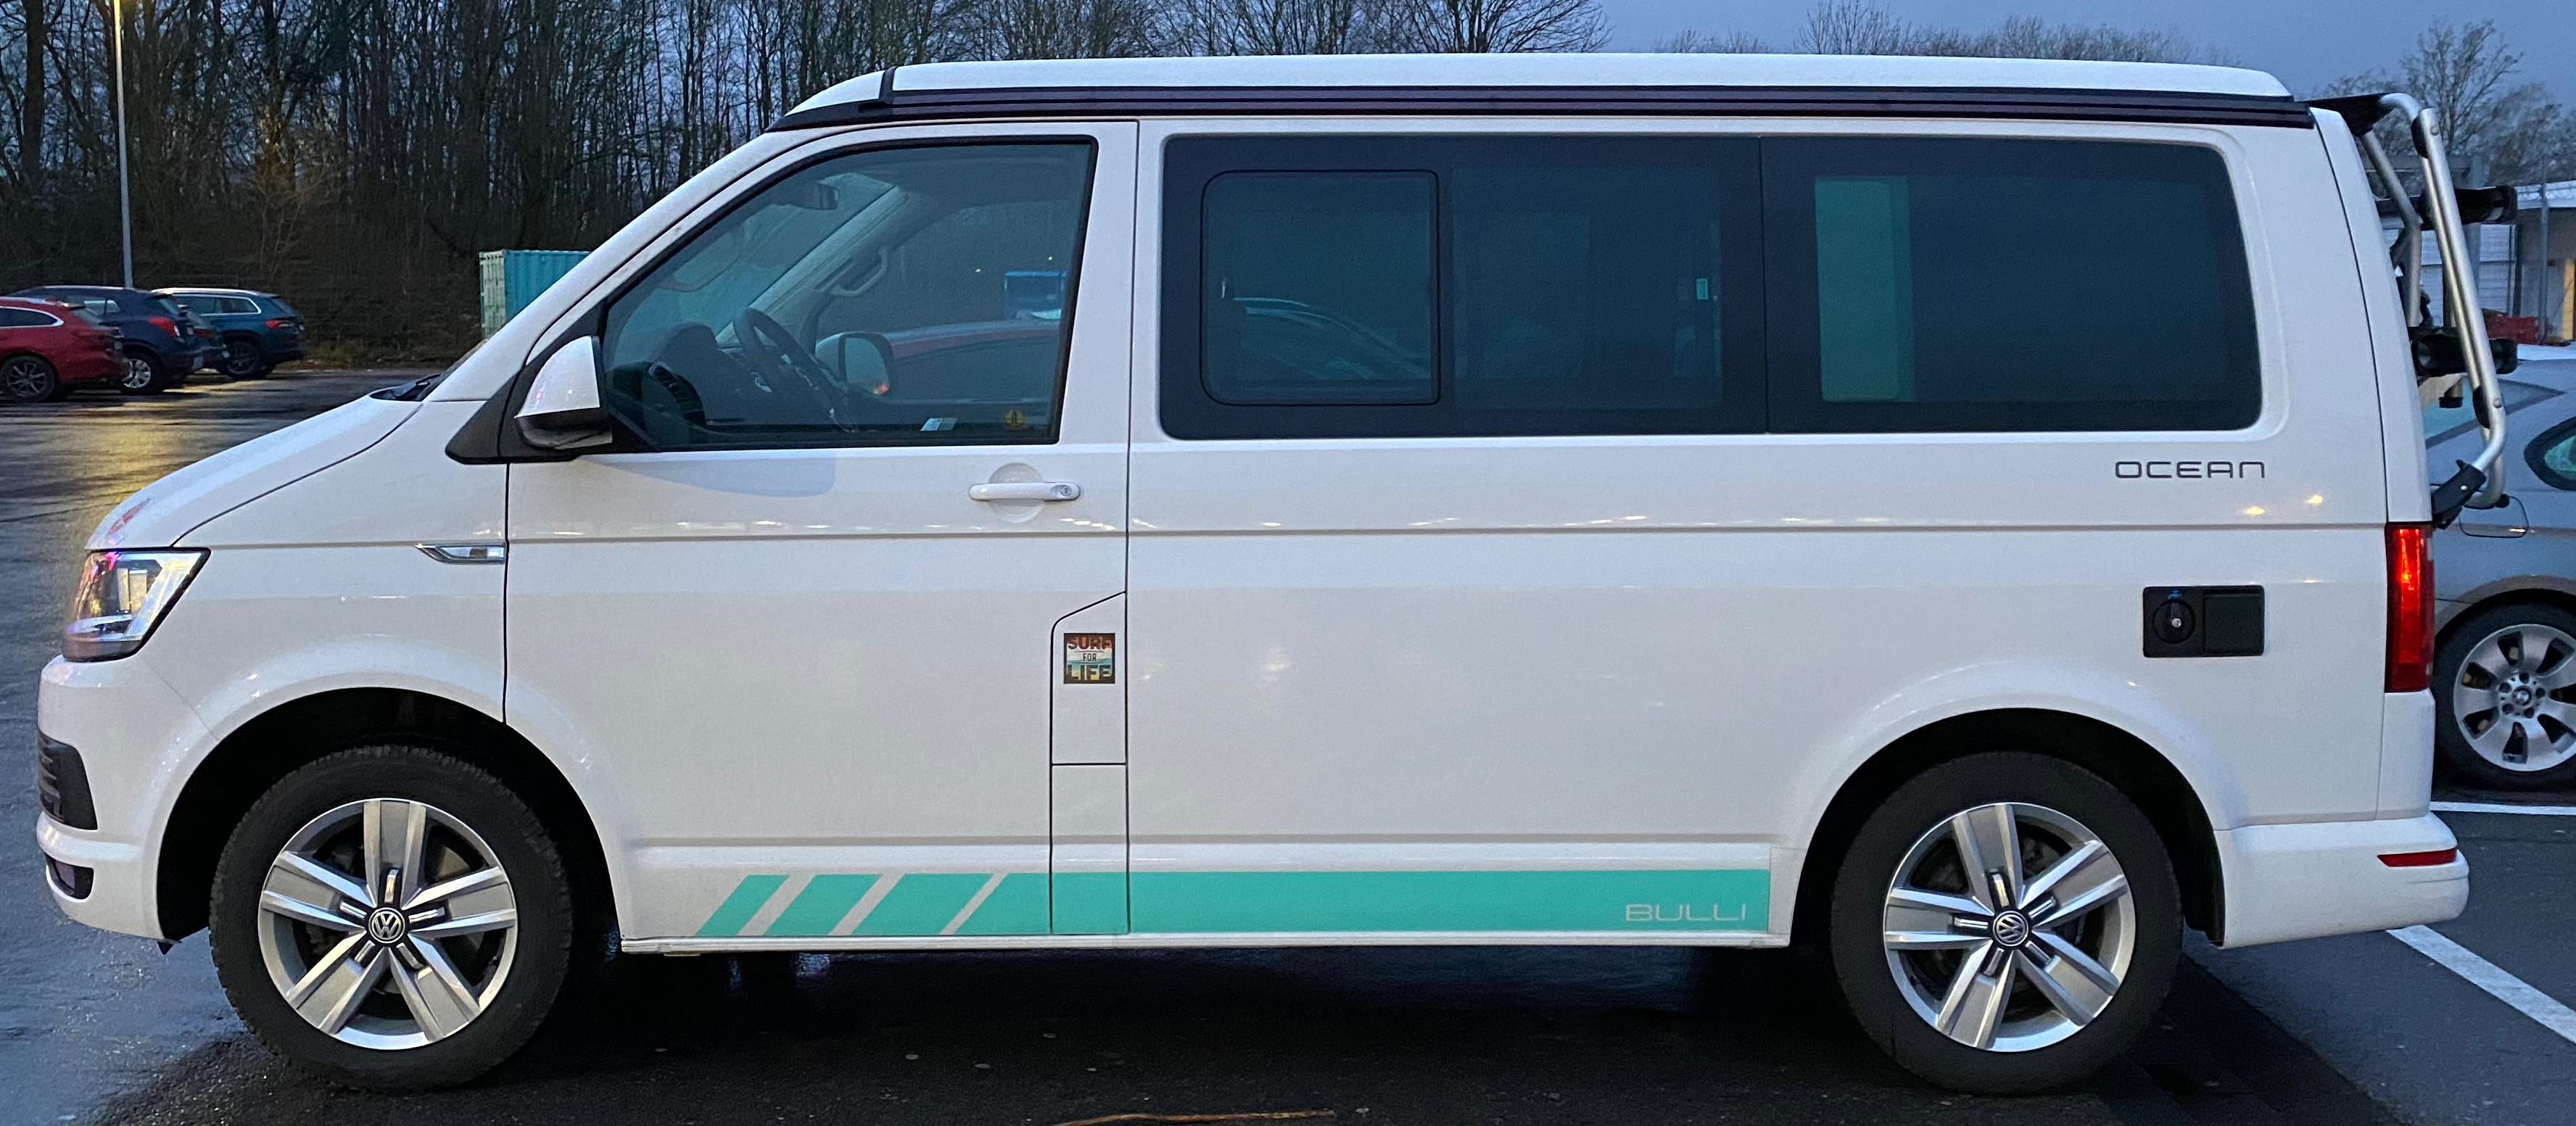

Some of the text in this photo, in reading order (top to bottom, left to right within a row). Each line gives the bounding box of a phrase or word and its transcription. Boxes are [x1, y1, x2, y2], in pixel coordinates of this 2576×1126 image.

[2115, 461, 2265, 479] OCEAN
[1067, 637, 1112, 650] SURF
[1083, 653, 1097, 662] FOR
[1067, 664, 1112, 681] LIFE
[1625, 903, 1746, 922] BULLI
[371, 911, 402, 940] VW
